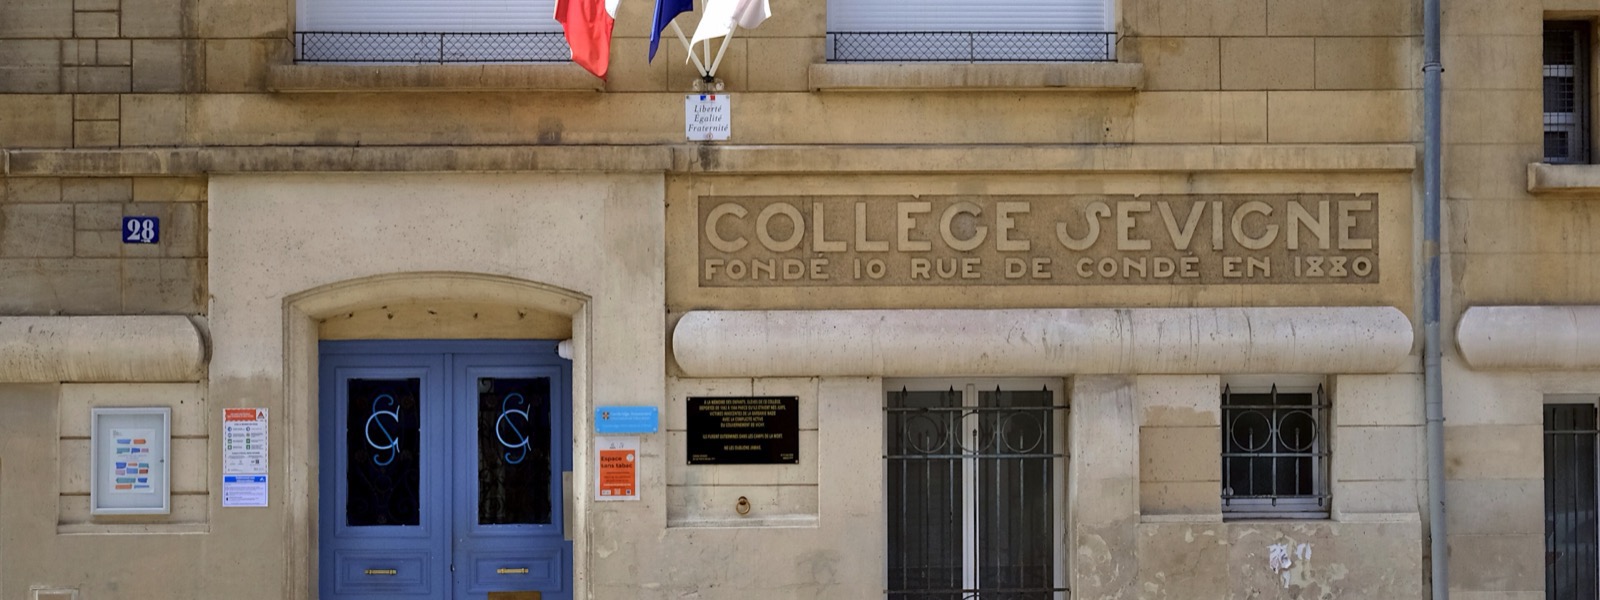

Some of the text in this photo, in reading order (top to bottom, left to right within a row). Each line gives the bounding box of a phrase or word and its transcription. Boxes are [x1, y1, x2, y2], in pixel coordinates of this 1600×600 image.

[694, 104, 722, 112] Liberté
[694, 112, 723, 124] Égalité
[127, 218, 155, 240] 28
[705, 253, 830, 280] FONDÉ
[911, 258, 981, 279] RUE
[1004, 257, 1052, 279] DE
[1076, 252, 1200, 278] CONDÉ
[1222, 256, 1271, 278] EN
[1294, 256, 1373, 278] 1880
